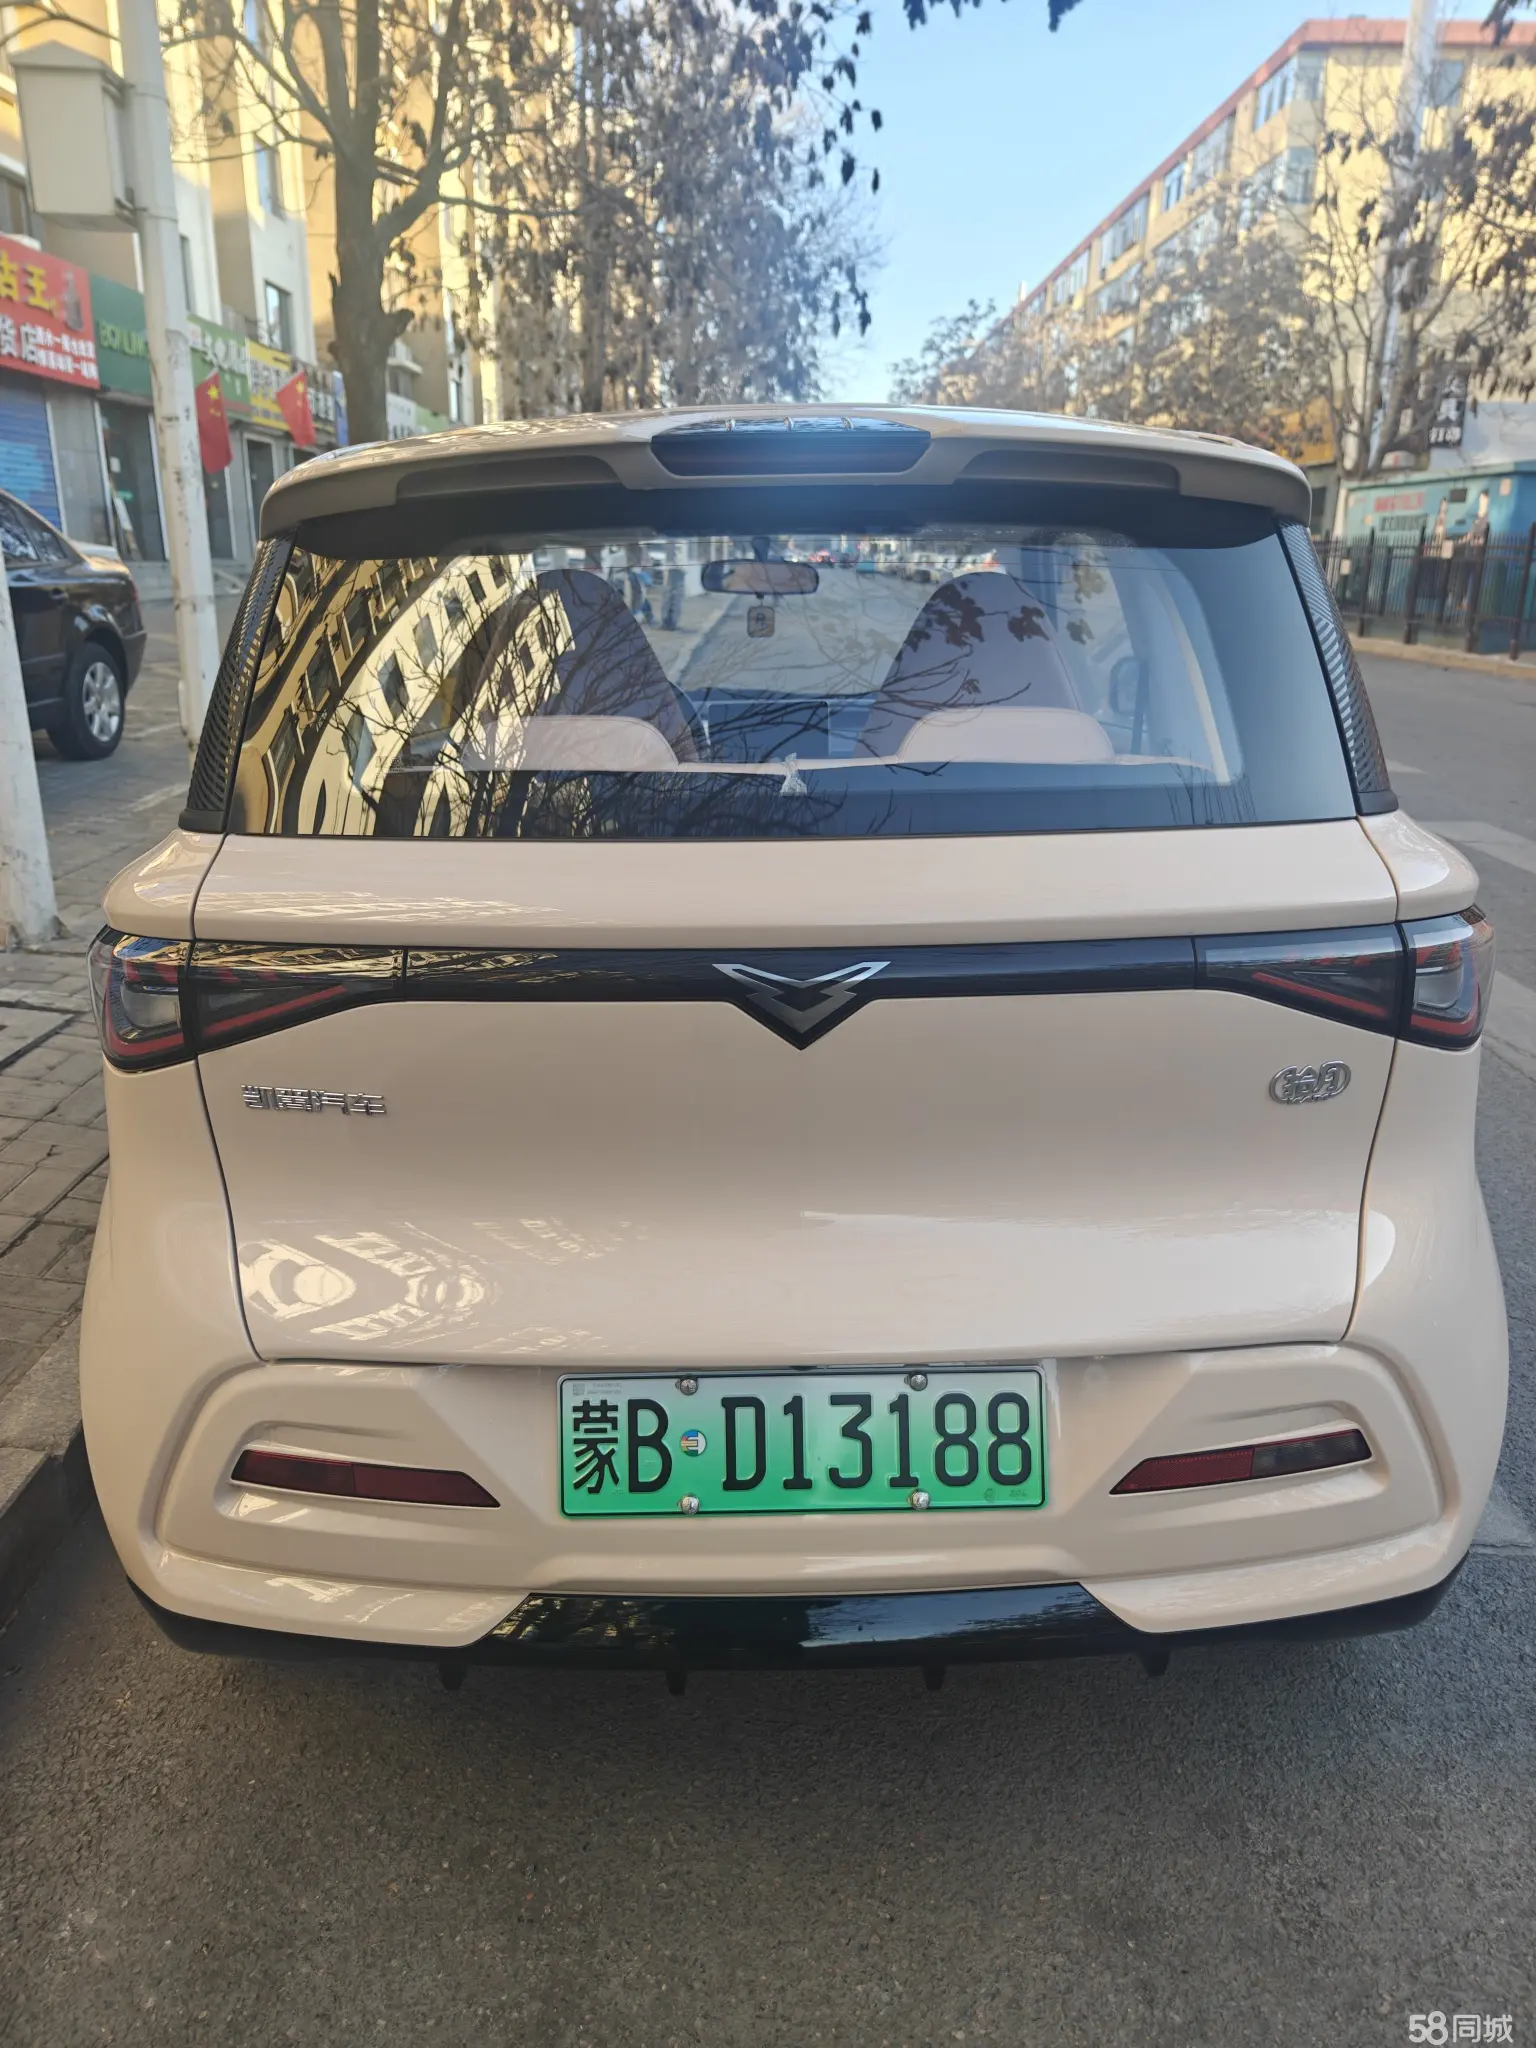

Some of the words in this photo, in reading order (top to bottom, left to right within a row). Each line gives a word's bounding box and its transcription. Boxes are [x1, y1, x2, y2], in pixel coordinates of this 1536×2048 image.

[241, 1084, 387, 1116] 凯翼汽车
[571, 1398, 673, 1494] 蒙B
[722, 1392, 1033, 1491] D13188
